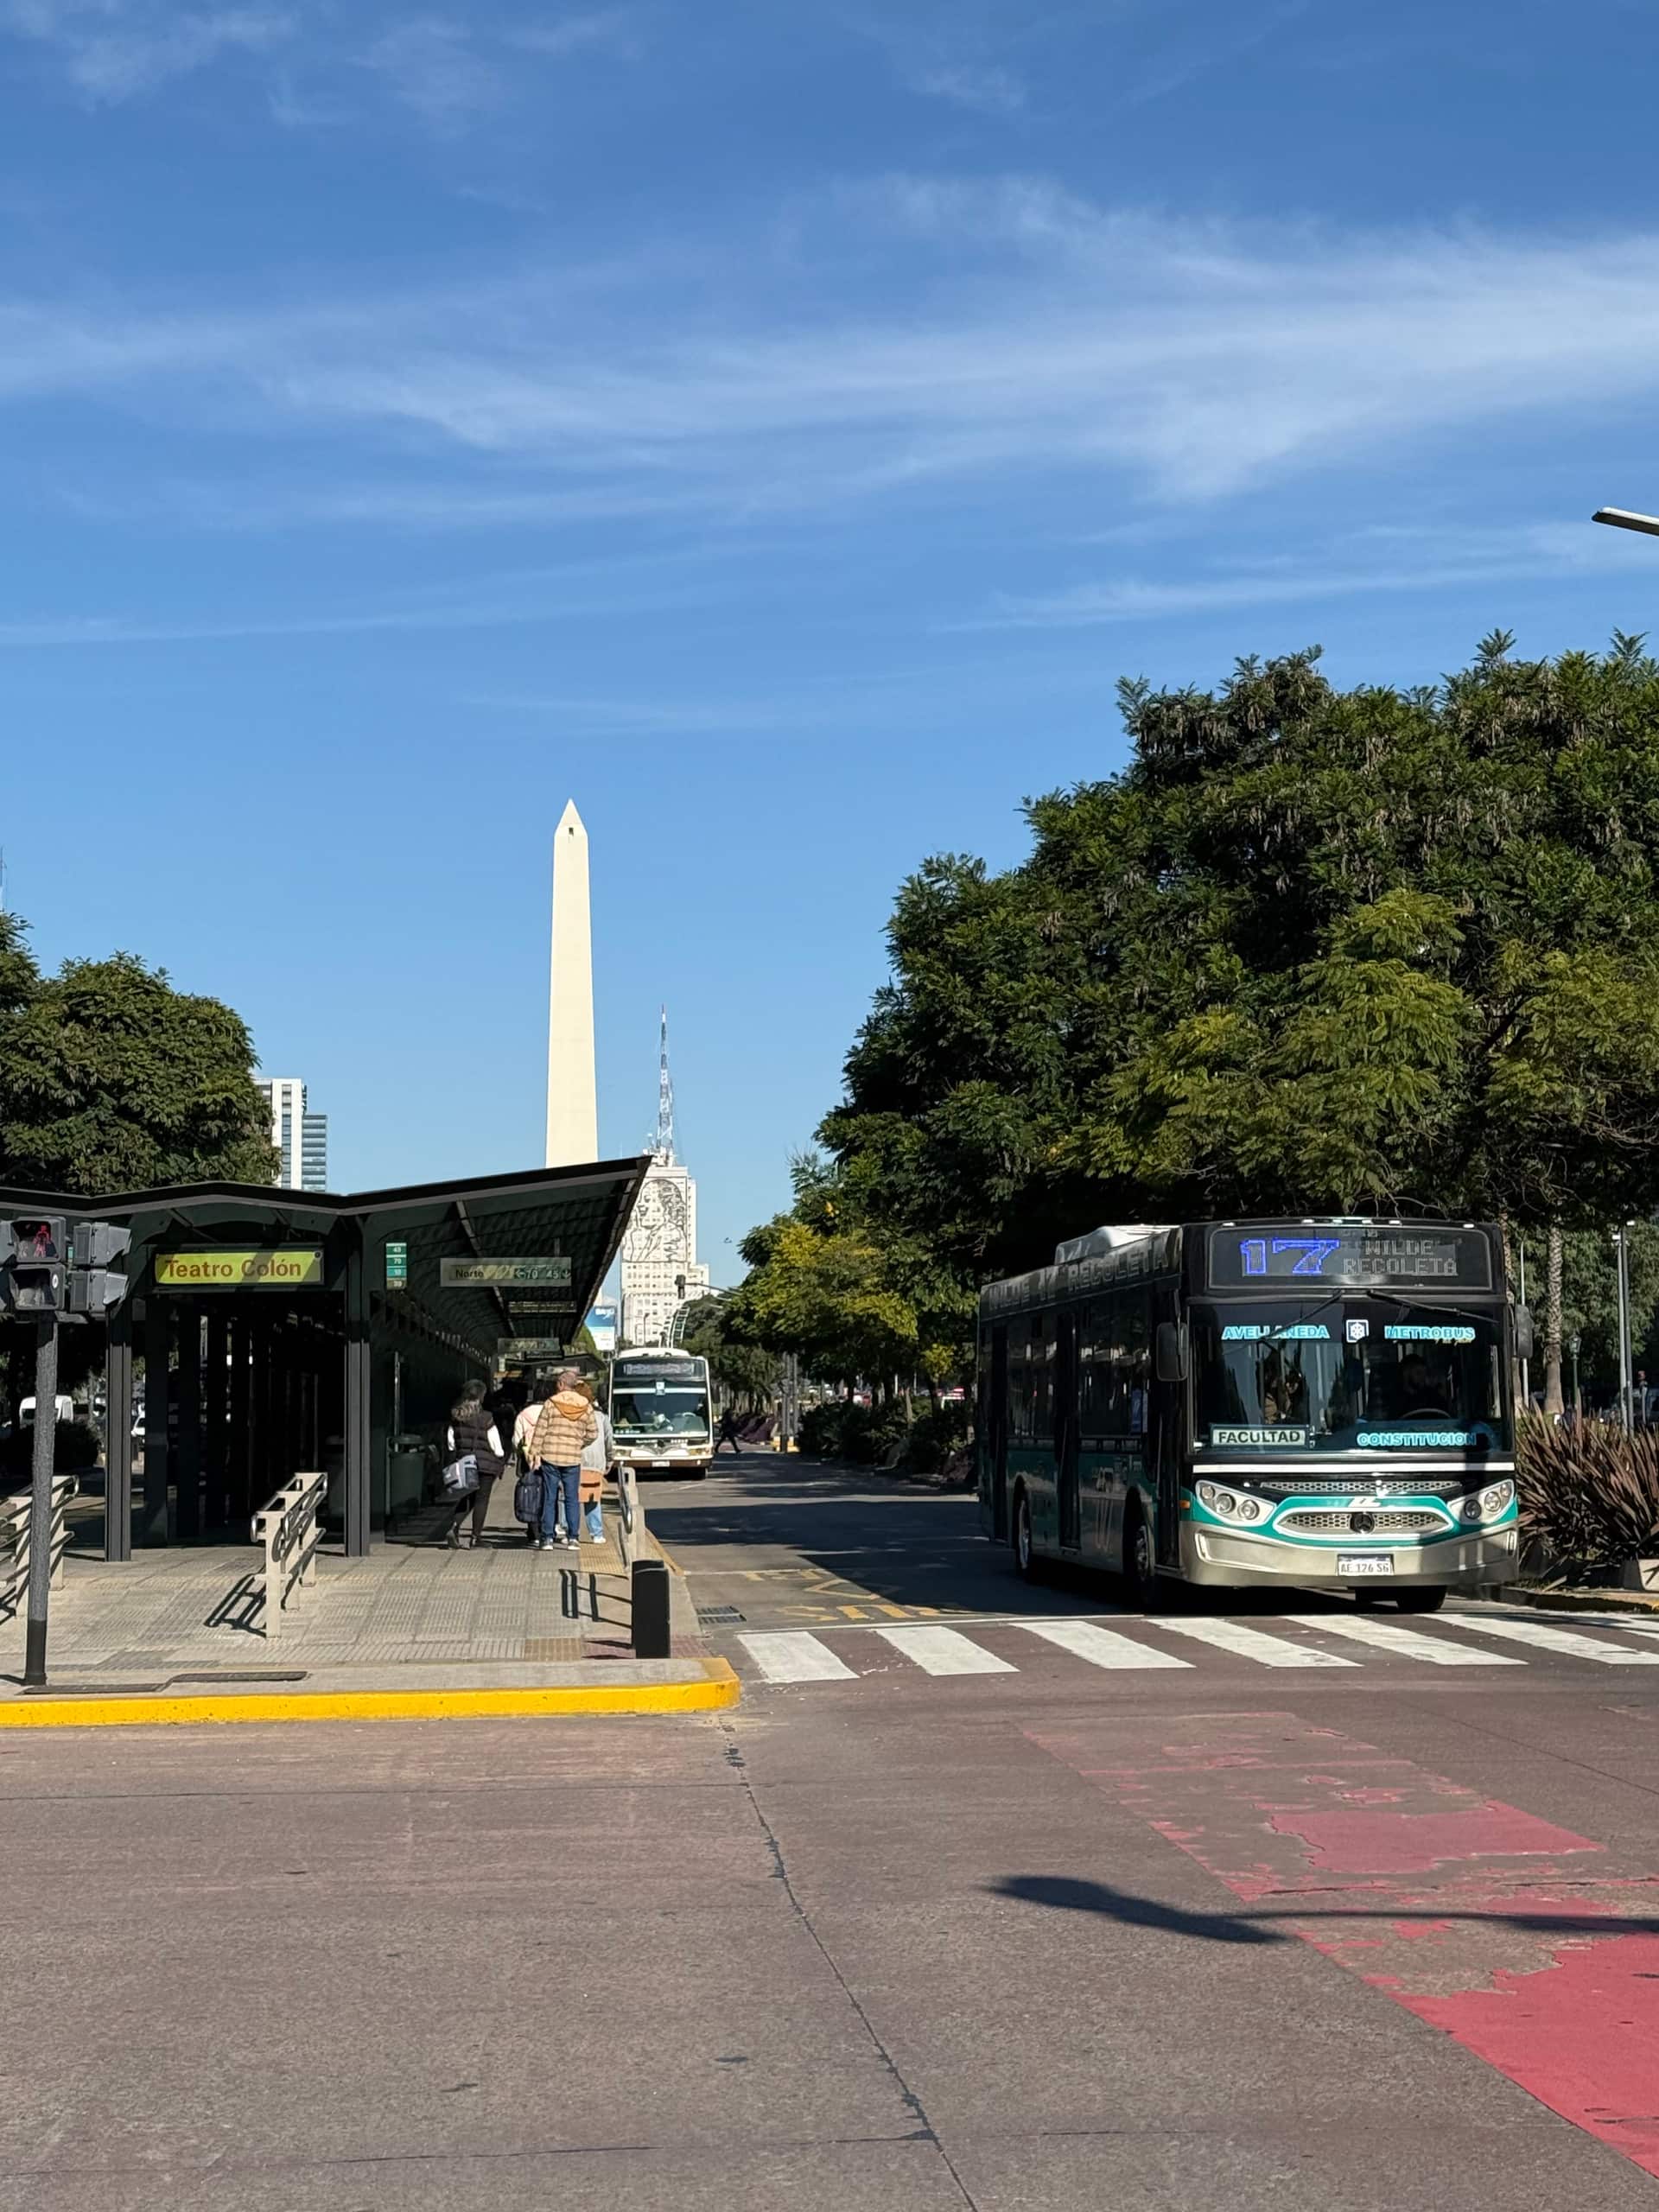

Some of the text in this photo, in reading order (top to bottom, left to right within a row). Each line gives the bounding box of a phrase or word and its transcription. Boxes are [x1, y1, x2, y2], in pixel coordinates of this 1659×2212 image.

[1365, 1239, 1434, 1255] WILDE
[1239, 1237, 1340, 1274] 17
[164, 1258, 302, 1278] Teatro Colón
[1343, 1257, 1459, 1275] RECOLETA
[1384, 1325, 1476, 1340] METROBUS
[1218, 1430, 1300, 1444] FACULTAD
[1357, 1433, 1477, 1446] CONSTITUCION
